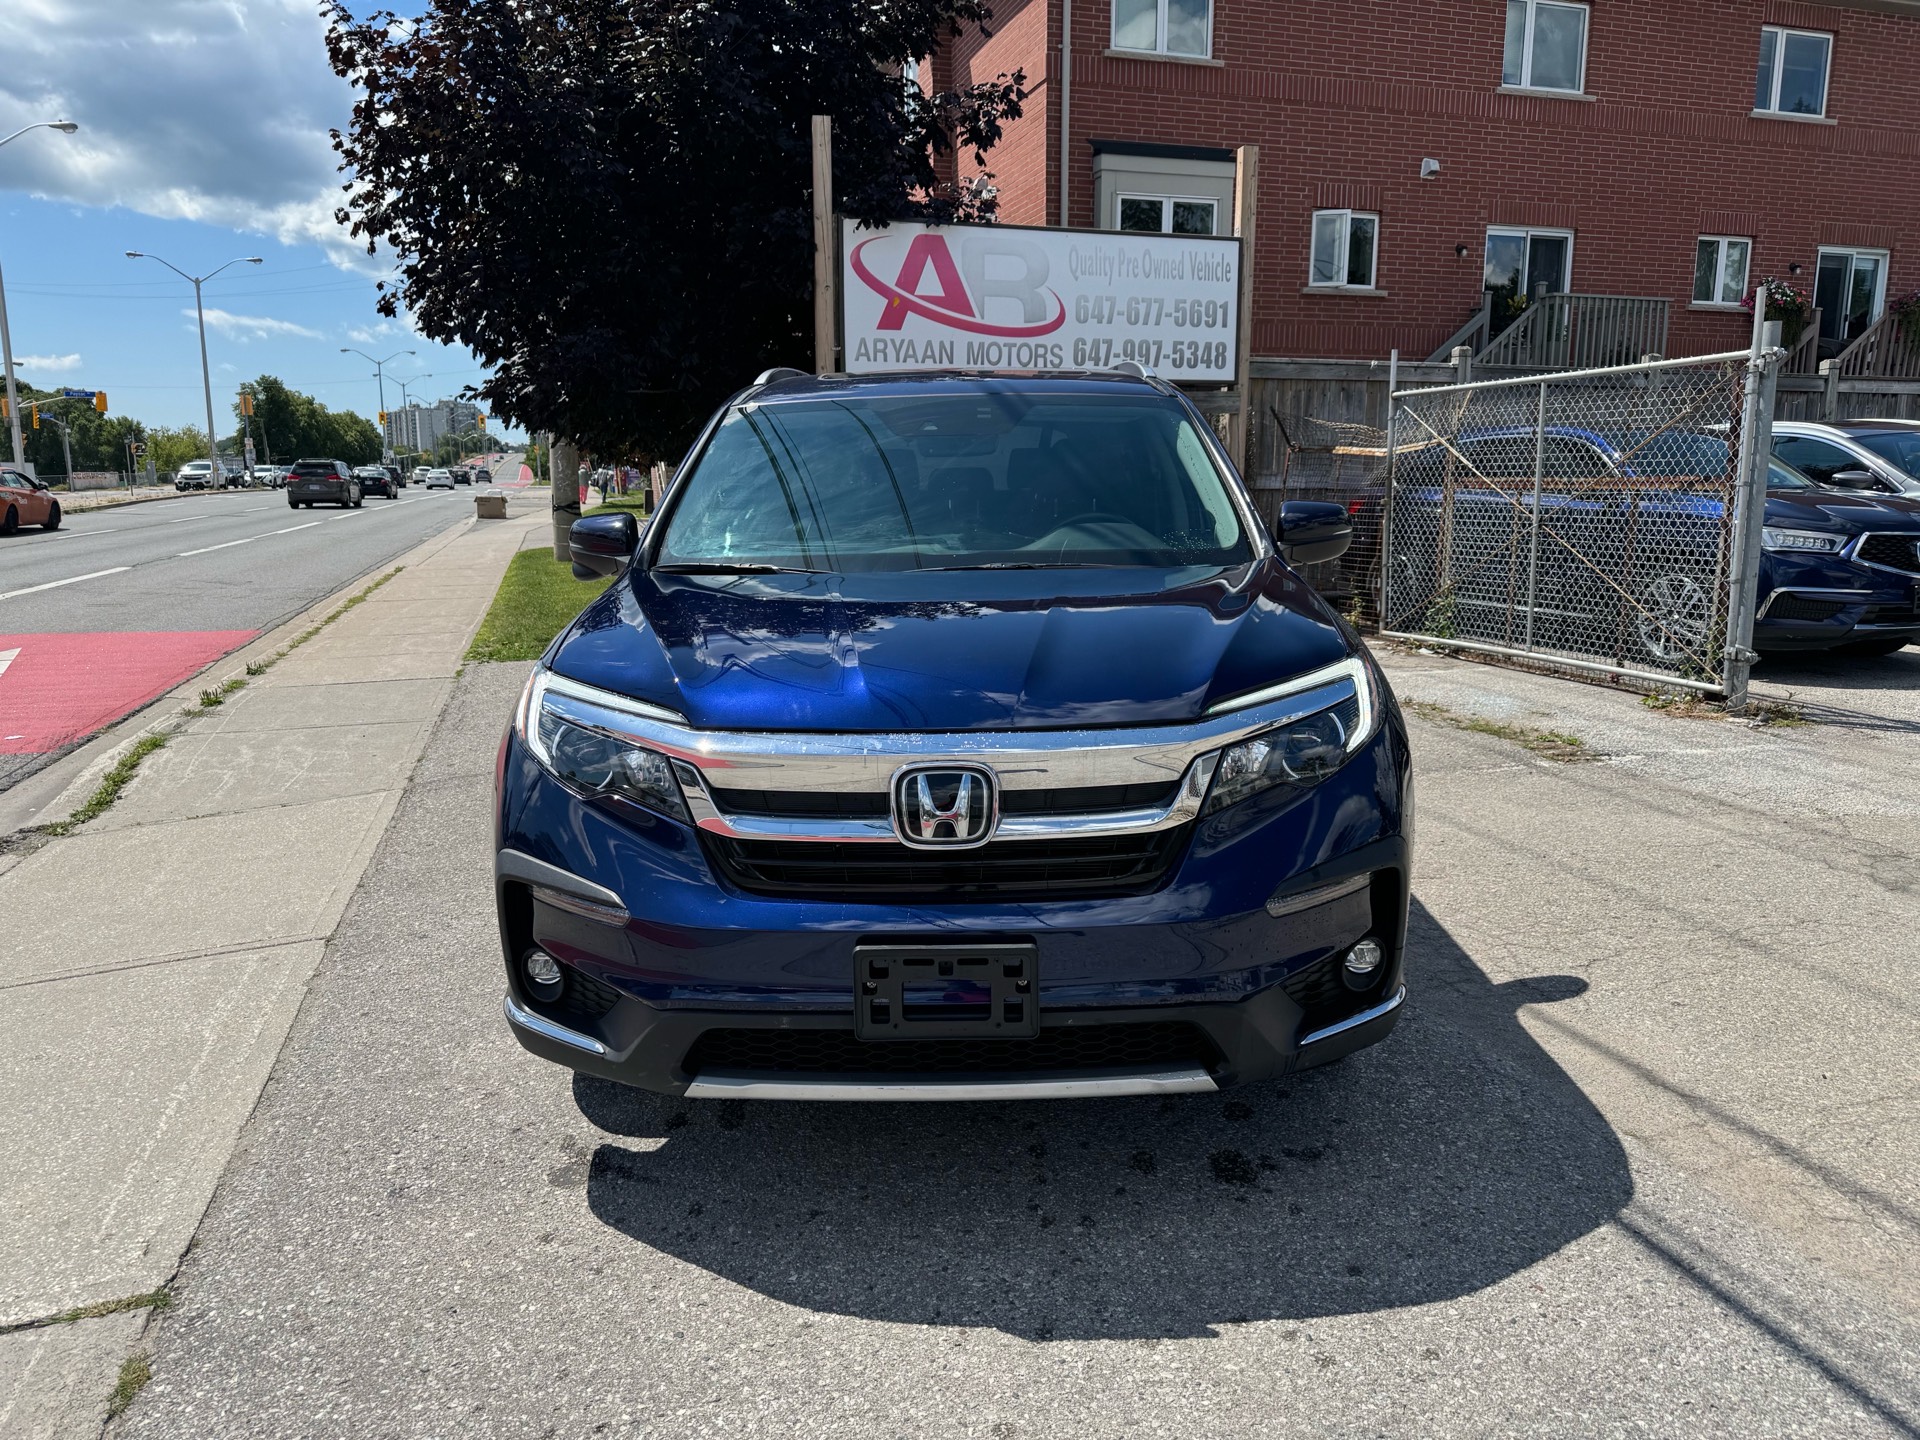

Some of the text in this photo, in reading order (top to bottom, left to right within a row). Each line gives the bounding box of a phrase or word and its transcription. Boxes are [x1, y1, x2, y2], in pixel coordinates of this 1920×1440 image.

[1069, 244, 1231, 286] Quality Pre Owned Vehicle
[1075, 294, 1229, 328] 647-677-5691
[854, 337, 1064, 368] ARYAAN MOTORS
[1073, 337, 1227, 369] 647-997-5348
